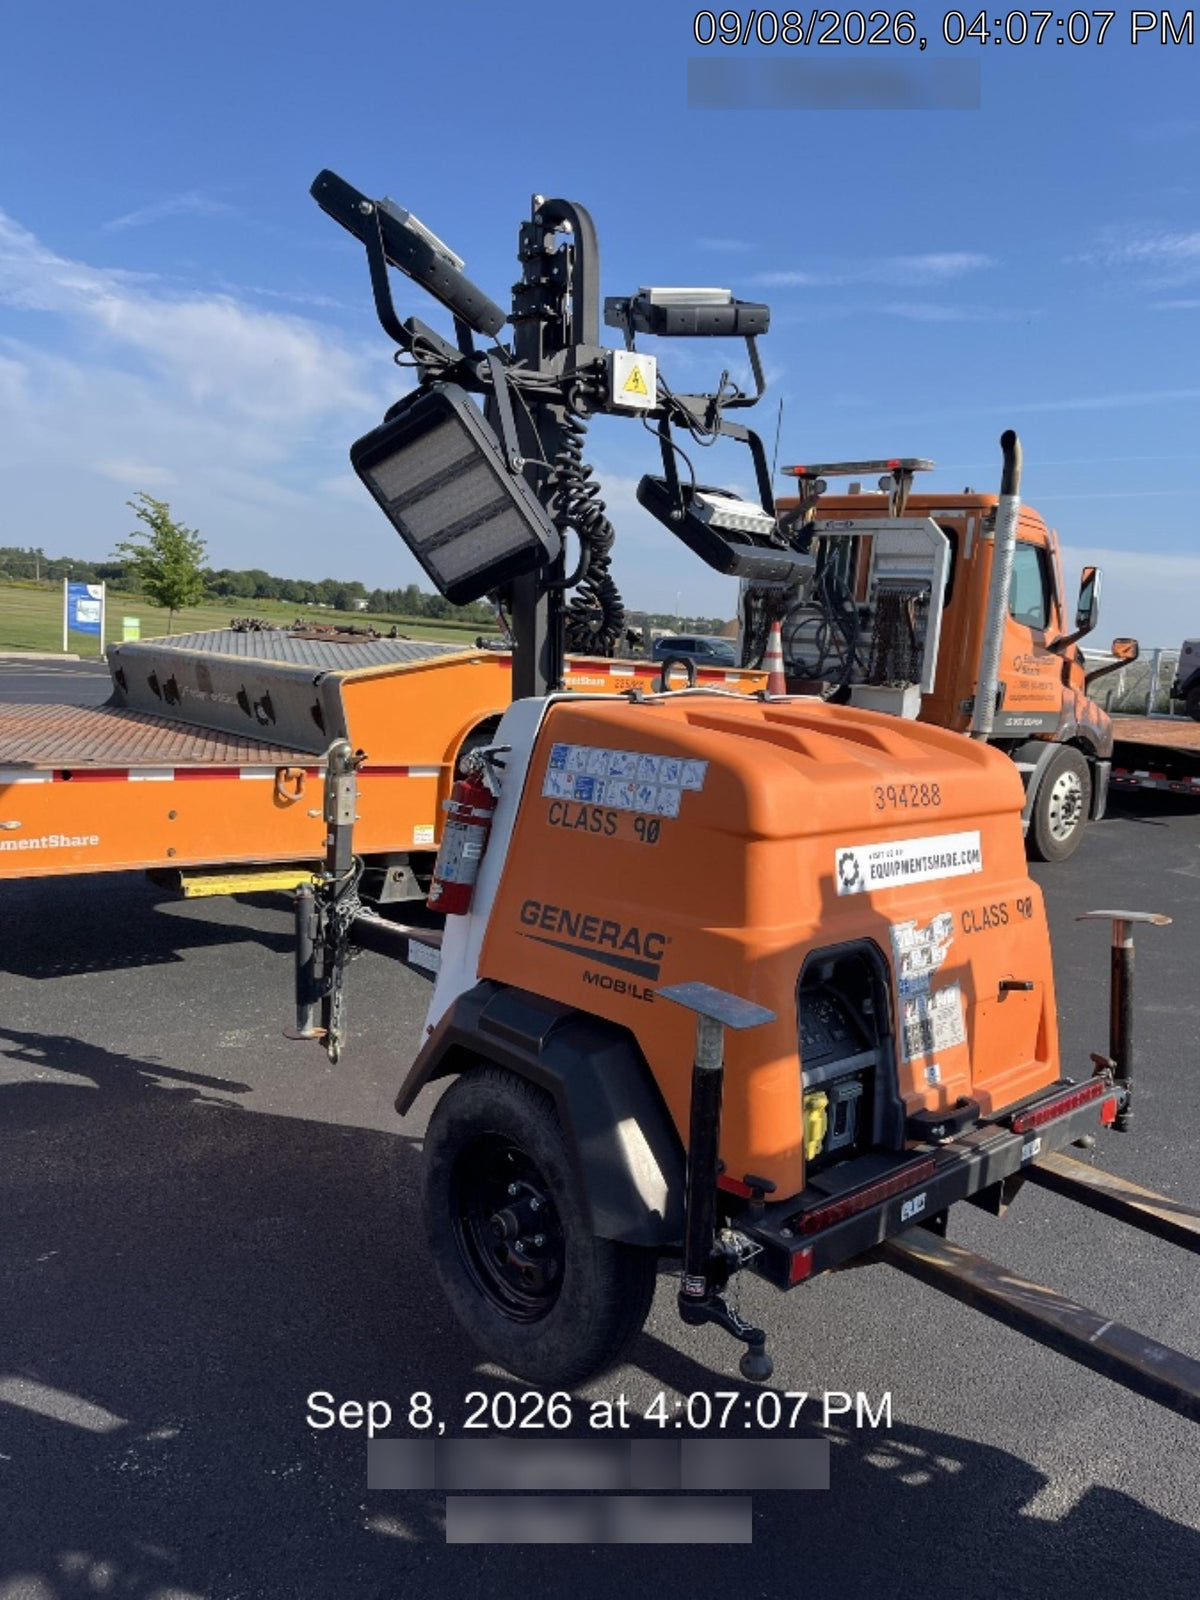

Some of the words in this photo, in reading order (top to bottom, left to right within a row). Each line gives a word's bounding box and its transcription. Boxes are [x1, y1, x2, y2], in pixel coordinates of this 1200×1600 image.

[874, 783, 942, 810] 394288
[548, 801, 619, 836] CLASS
[633, 816, 661, 844] 90
[0, 834, 99, 850] mentShare
[870, 849, 980, 880] EQUIPMENTSHARE.COM
[520, 899, 666, 961] GENERAC
[961, 902, 1009, 934] CLASS
[1016, 896, 1033, 918] 90
[582, 970, 655, 1003] MOBILE
